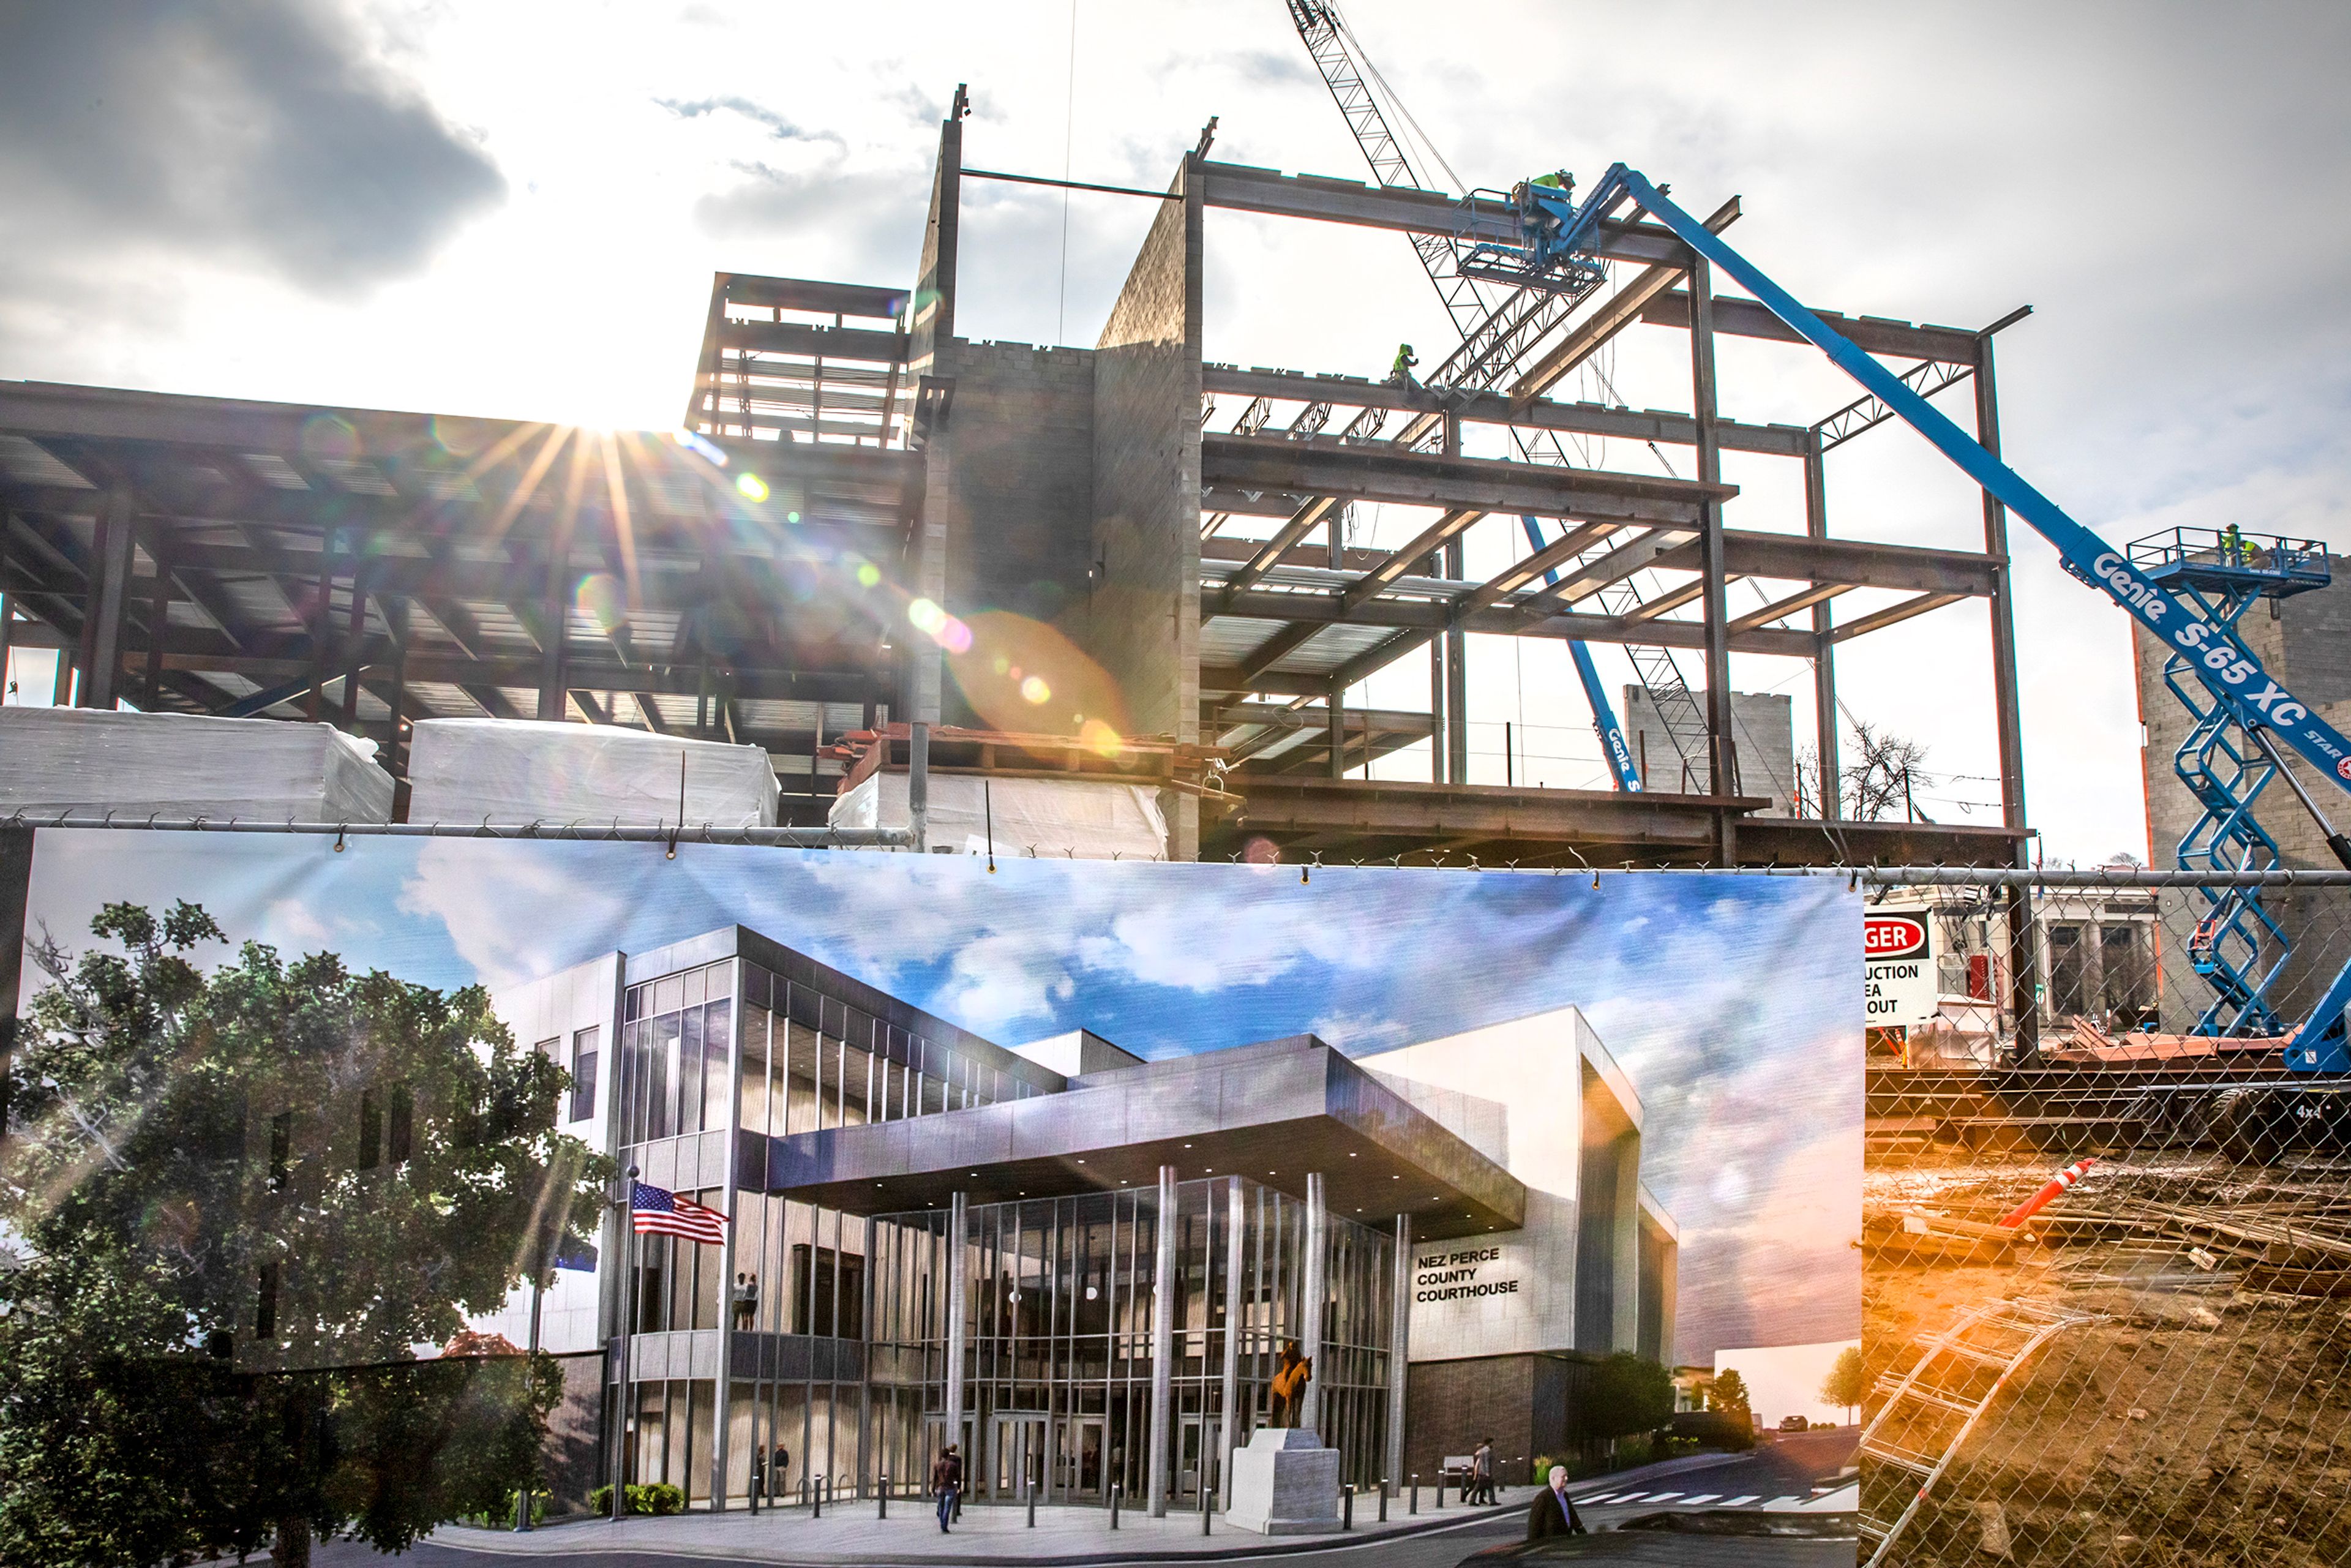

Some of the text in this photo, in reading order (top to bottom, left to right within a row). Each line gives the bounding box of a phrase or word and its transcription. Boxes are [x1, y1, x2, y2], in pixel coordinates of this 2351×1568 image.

[2094, 552, 2307, 726] Genie S-65 XC
[1608, 728, 1630, 773] Genie
[2303, 730, 2343, 759] STAR
[1865, 926, 1908, 948] GER
[1865, 965, 1918, 980] UCTION
[1867, 1000, 1897, 1014] OUT
[2297, 1105, 2321, 1119] 4x4
[1418, 1248, 1499, 1269] NEZ PERCE
[1417, 1268, 1477, 1286] COUNTY
[1417, 1280, 1518, 1302] COURTHOUSE
